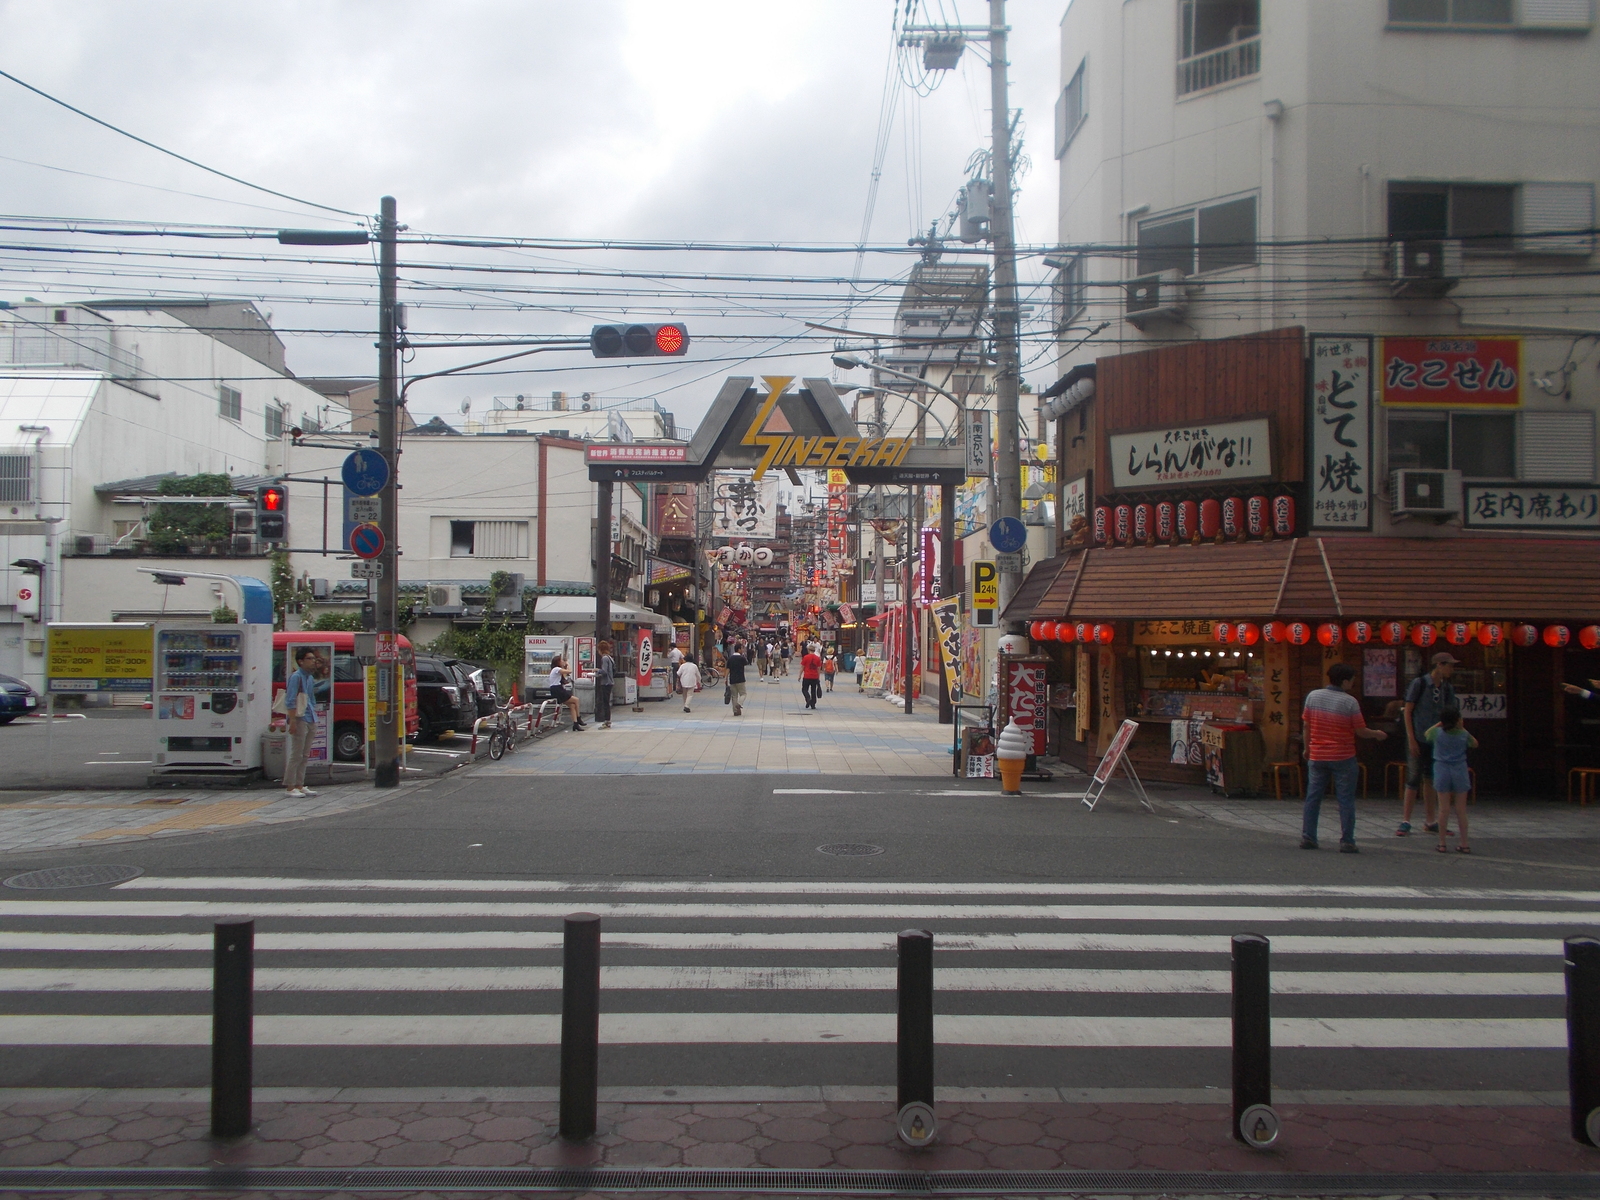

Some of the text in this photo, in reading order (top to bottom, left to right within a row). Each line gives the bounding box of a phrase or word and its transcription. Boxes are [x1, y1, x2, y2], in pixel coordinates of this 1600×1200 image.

[1317, 343, 1353, 358] 新世界
[1342, 356, 1368, 369] 名物
[1385, 356, 1517, 391] たこせん
[1322, 369, 1364, 495] どて焼
[1161, 503, 1171, 538] たこせん
[1315, 499, 1368, 512] お持ち帰り
[1473, 491, 1599, 520] 店内席あり
[1118, 507, 1129, 539] たこせん
[352, 570, 383, 578] ここから
[974, 562, 996, 594] P
[981, 584, 997, 594] 24h
[1139, 620, 1220, 636] 大たこ焼直
[640, 638, 653, 673] たばこ
[1033, 668, 1046, 730] 新世界名物
[1101, 667, 1111, 718] たこせん
[1268, 667, 1285, 726] どて焼
